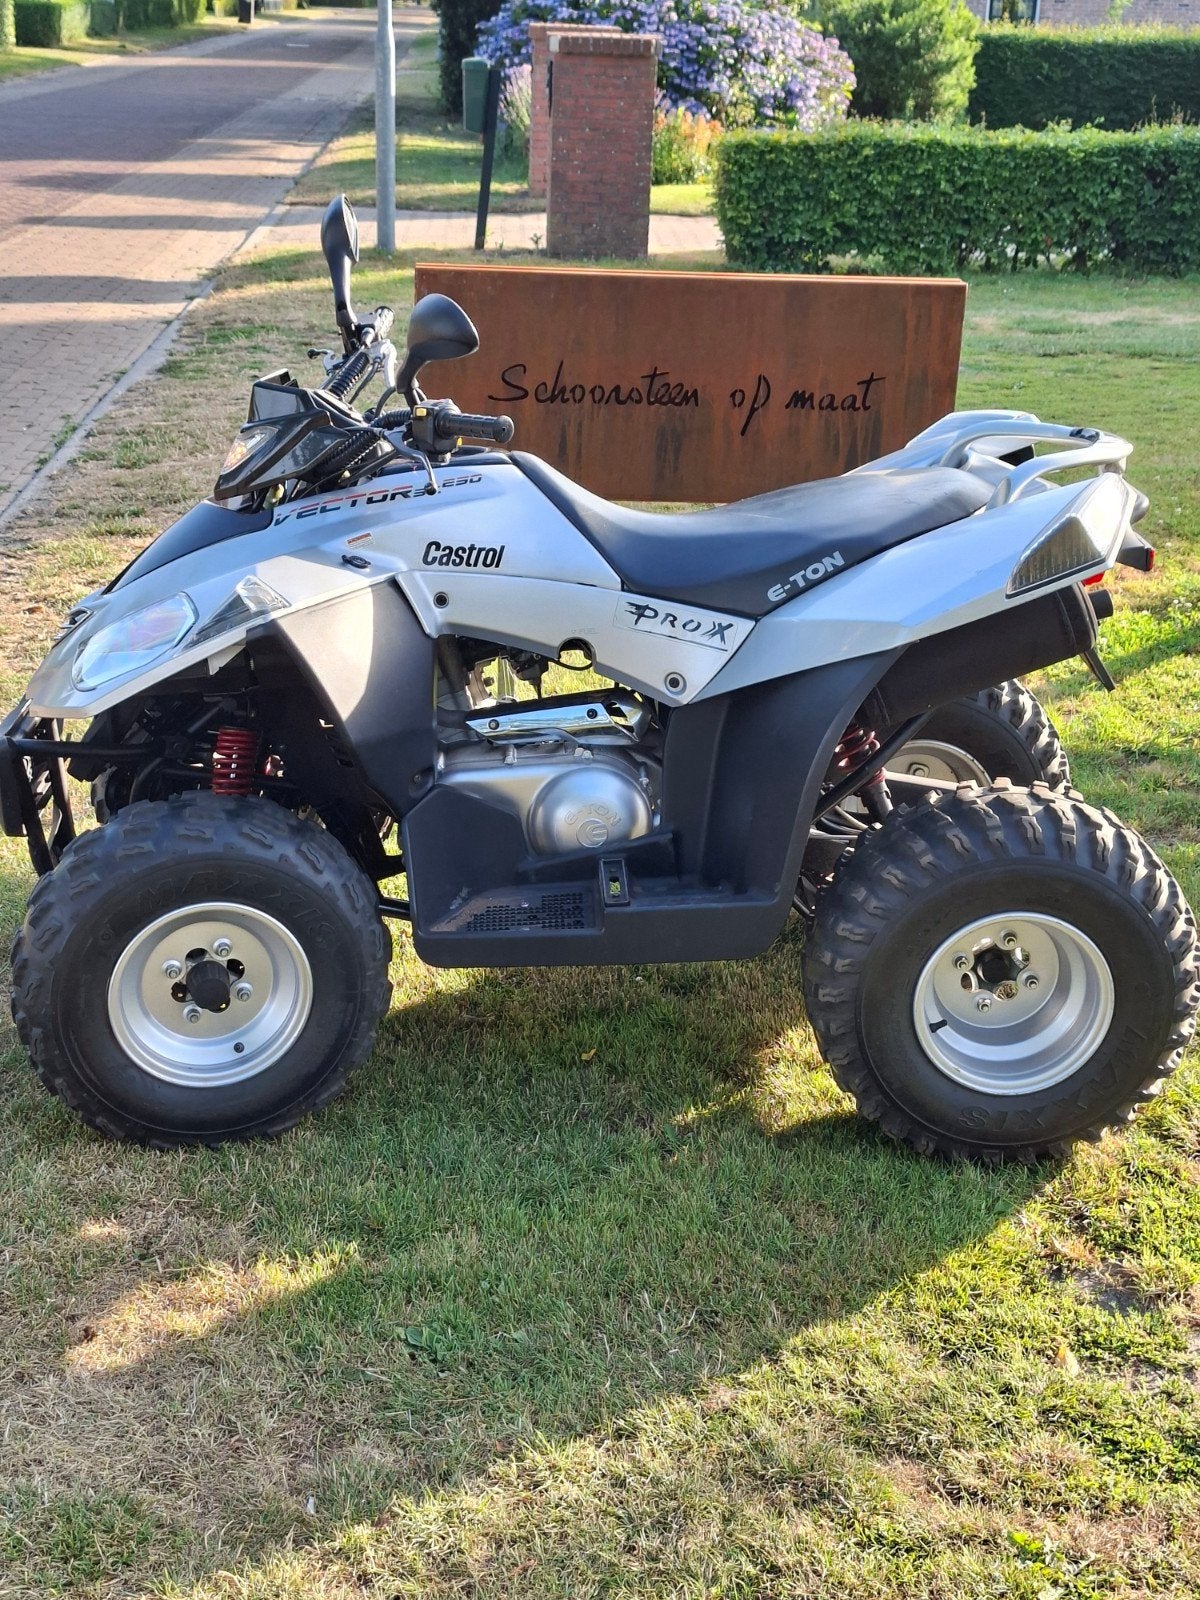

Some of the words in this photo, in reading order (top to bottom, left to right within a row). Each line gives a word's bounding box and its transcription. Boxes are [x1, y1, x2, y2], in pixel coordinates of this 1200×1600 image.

[488, 360, 699, 408] Schoorsteen
[729, 373, 771, 437] op
[784, 372, 887, 412] maat
[274, 484, 413, 527] VECTOR
[442, 473, 482, 488] 250
[422, 540, 505, 569] Castrol
[767, 550, 845, 602] E-TON
